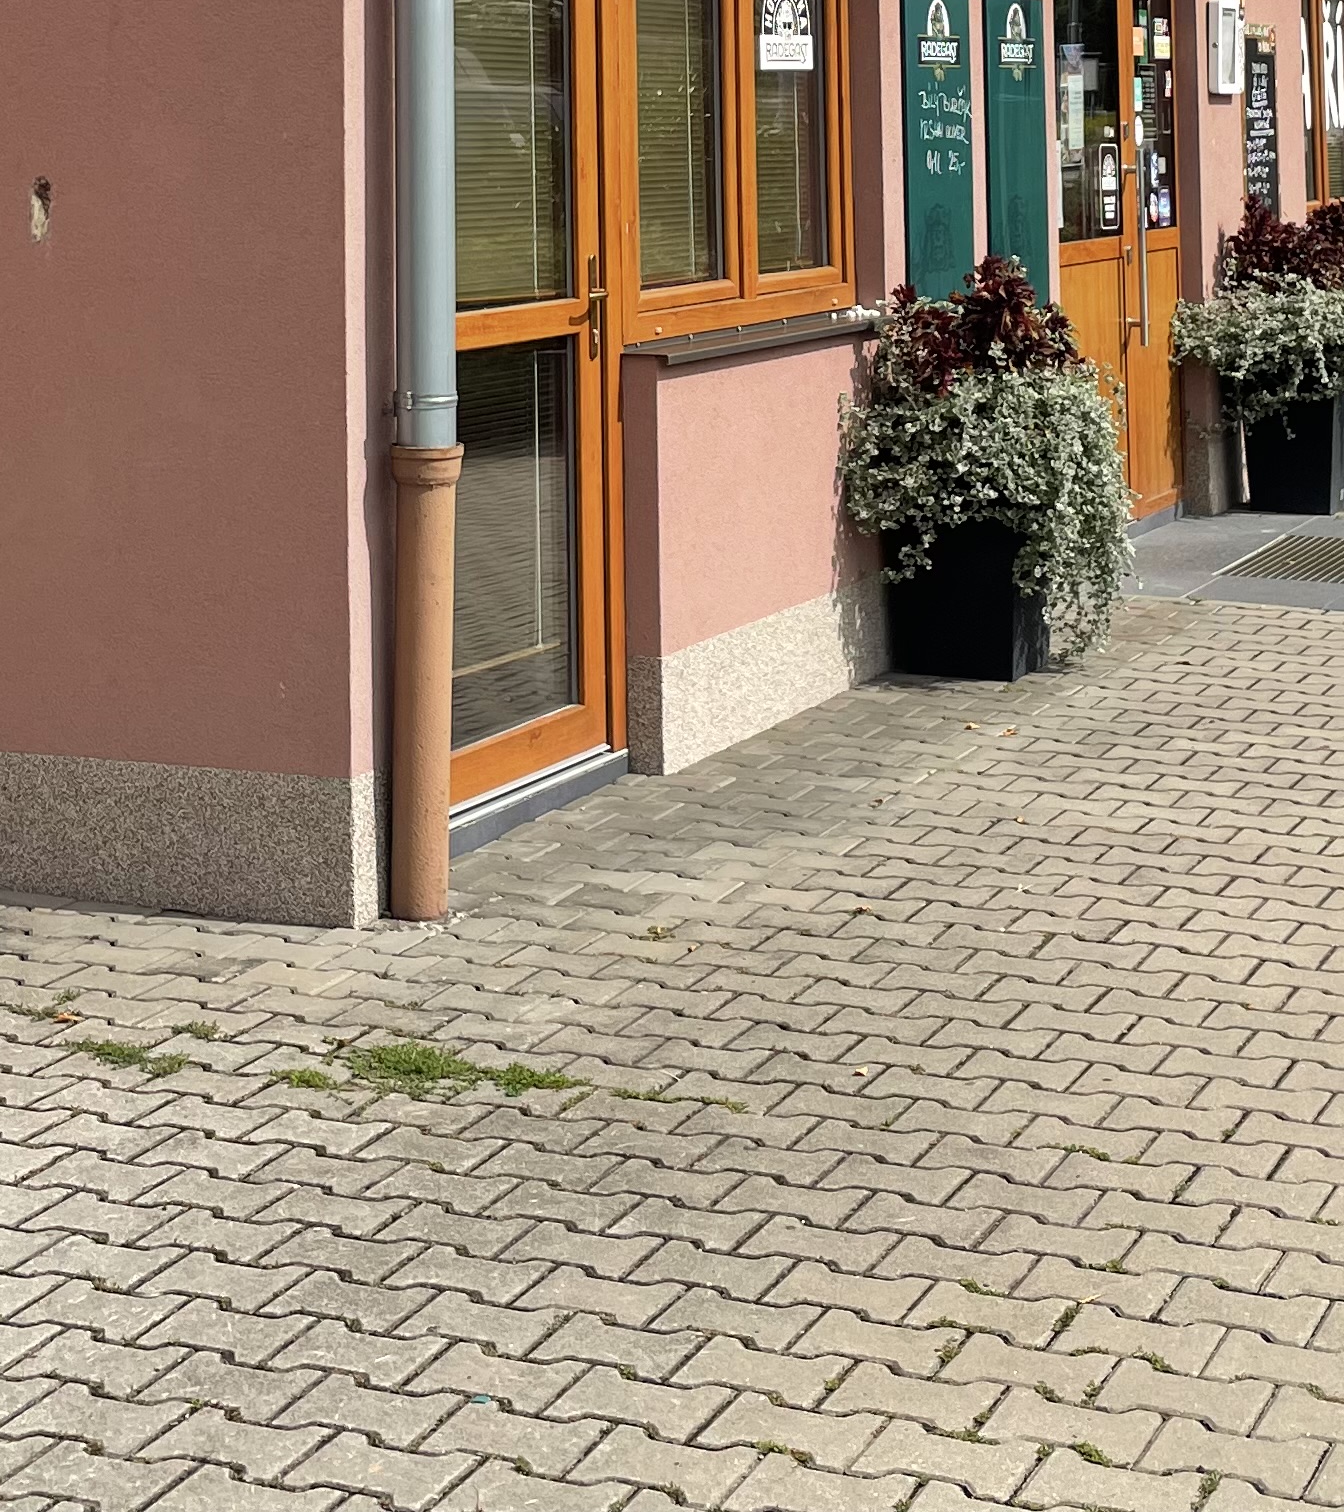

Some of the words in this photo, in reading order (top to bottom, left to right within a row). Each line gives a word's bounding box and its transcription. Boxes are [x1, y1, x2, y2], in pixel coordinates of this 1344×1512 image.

[766, 42, 809, 64] RADEGAST
[920, 40, 958, 64] RADEGAST
[1001, 42, 1035, 65] RADEGAST
